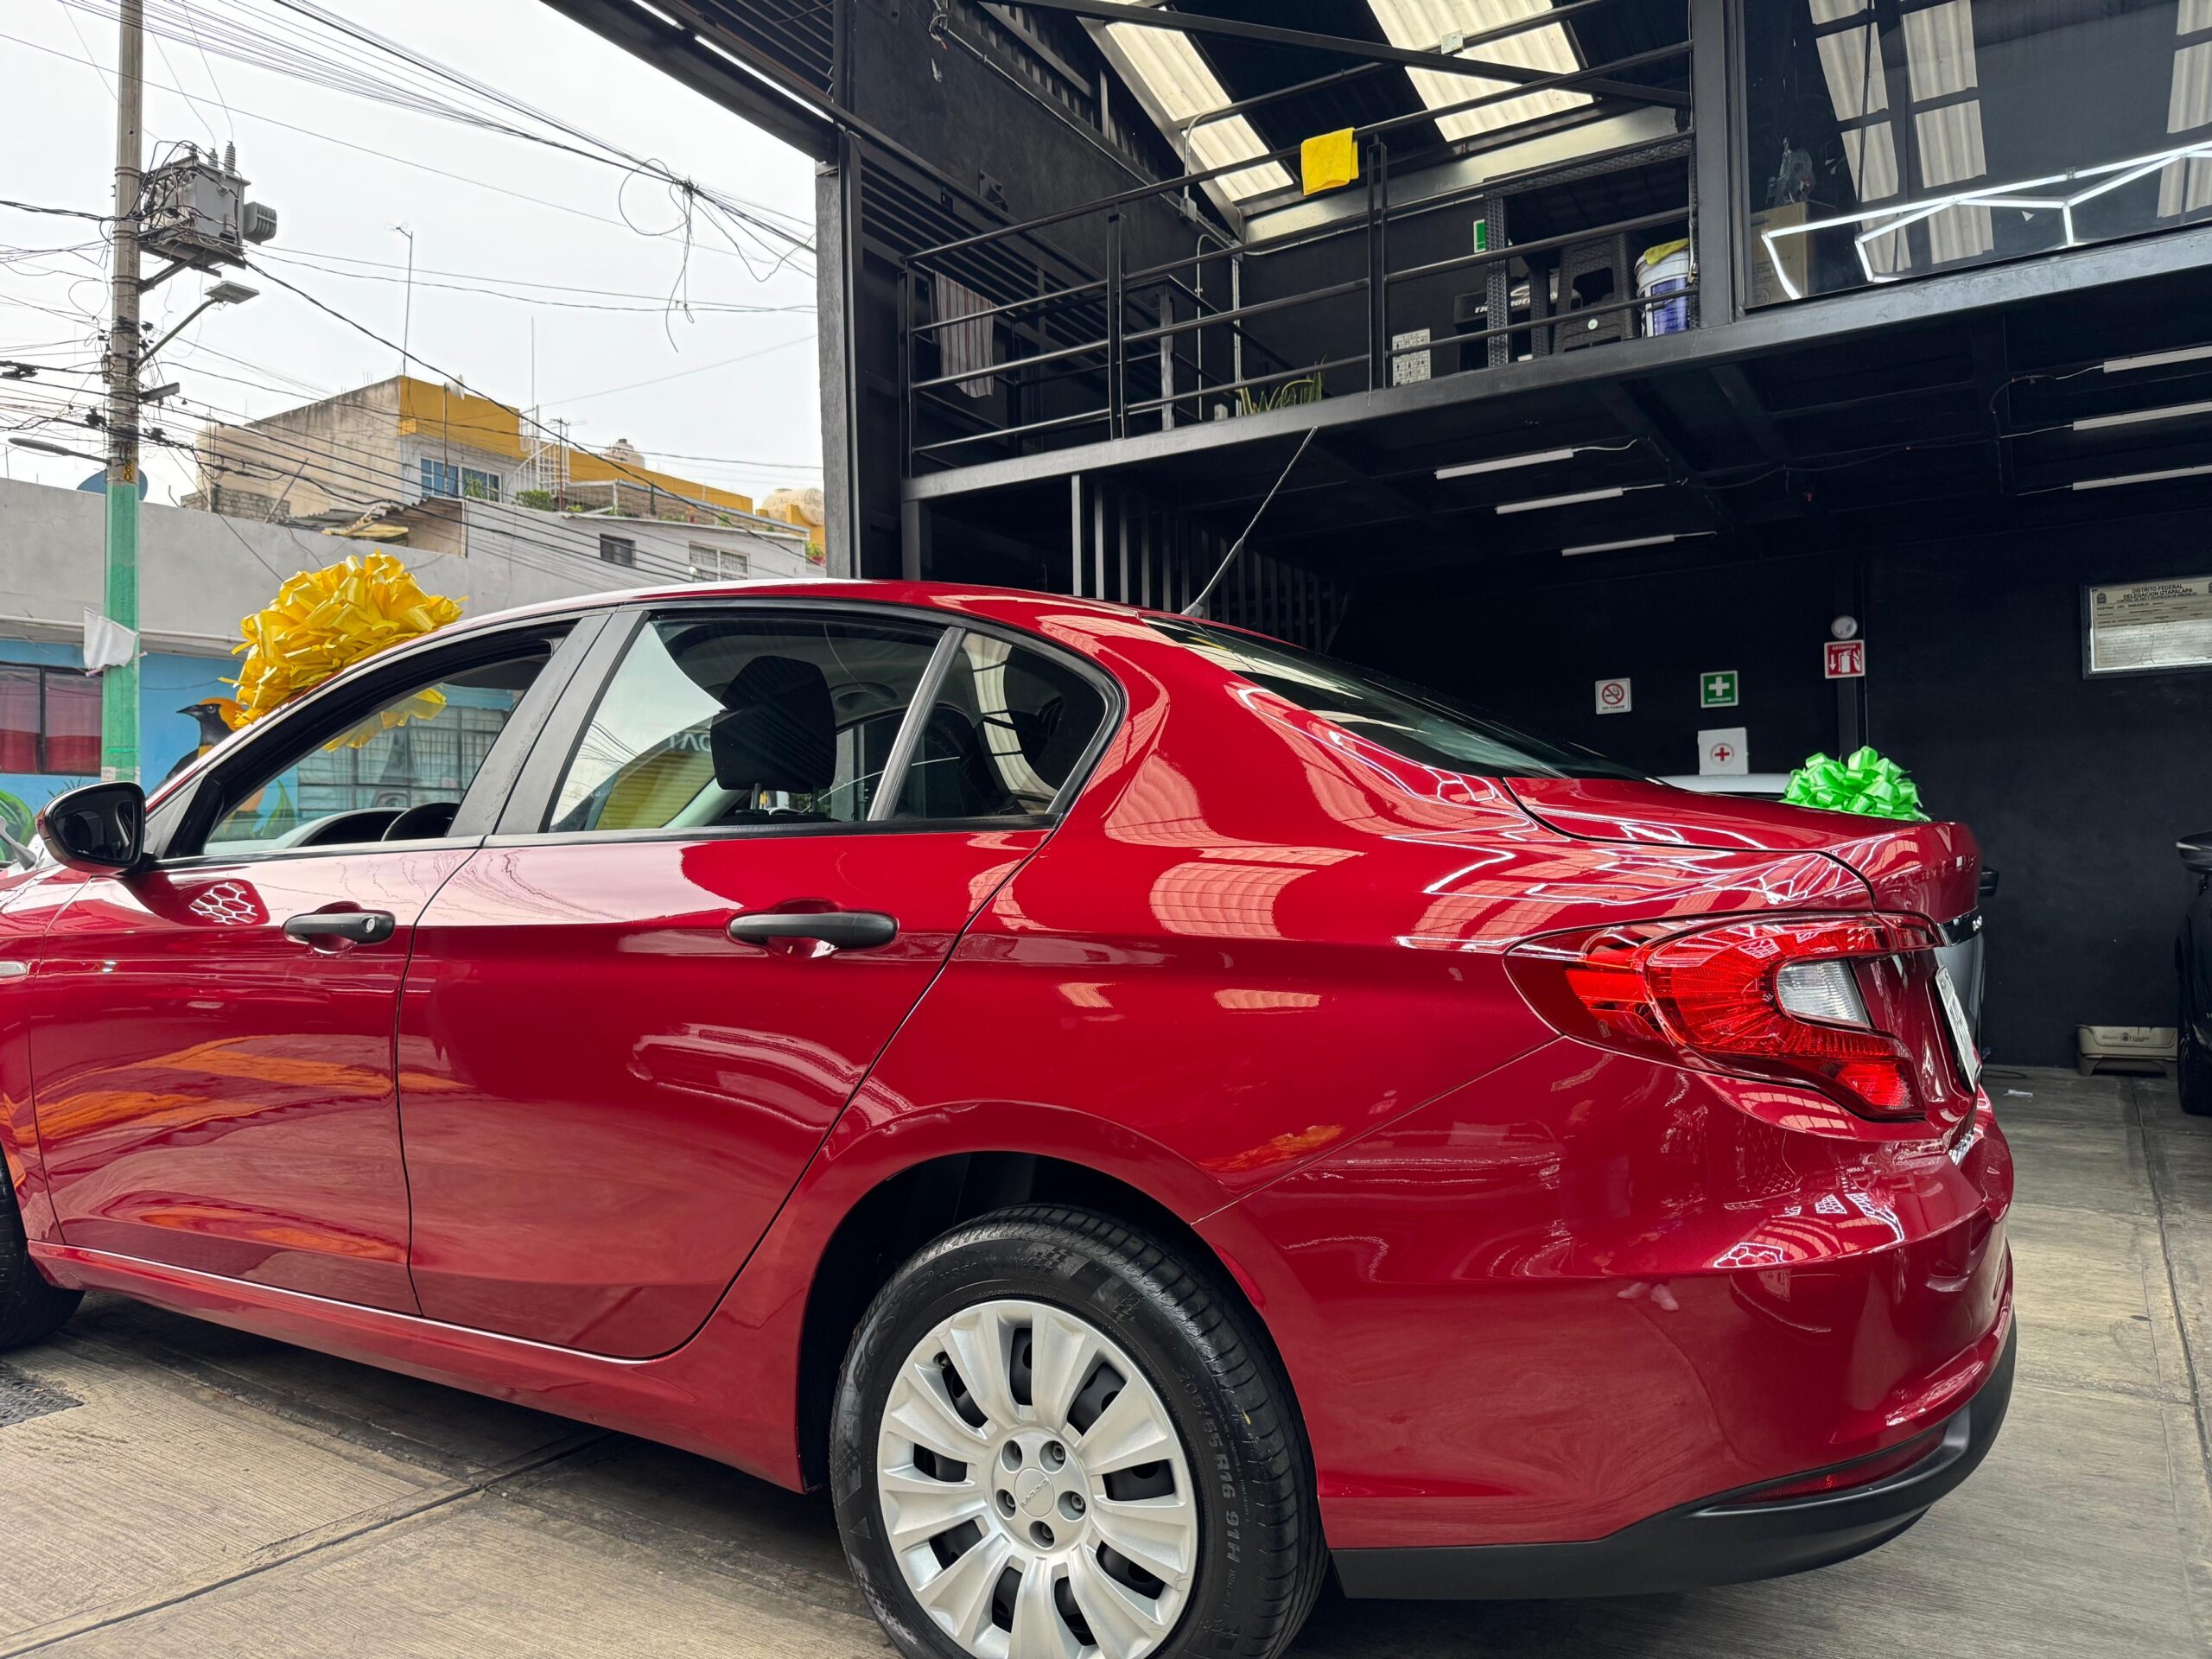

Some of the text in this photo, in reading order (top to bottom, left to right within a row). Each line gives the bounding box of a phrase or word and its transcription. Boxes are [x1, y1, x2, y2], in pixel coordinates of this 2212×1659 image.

[2159, 588, 2193, 596] IZTAPALAPA
[1214, 1453, 1236, 1499] R16
[1225, 1510, 1241, 1563] 91H
